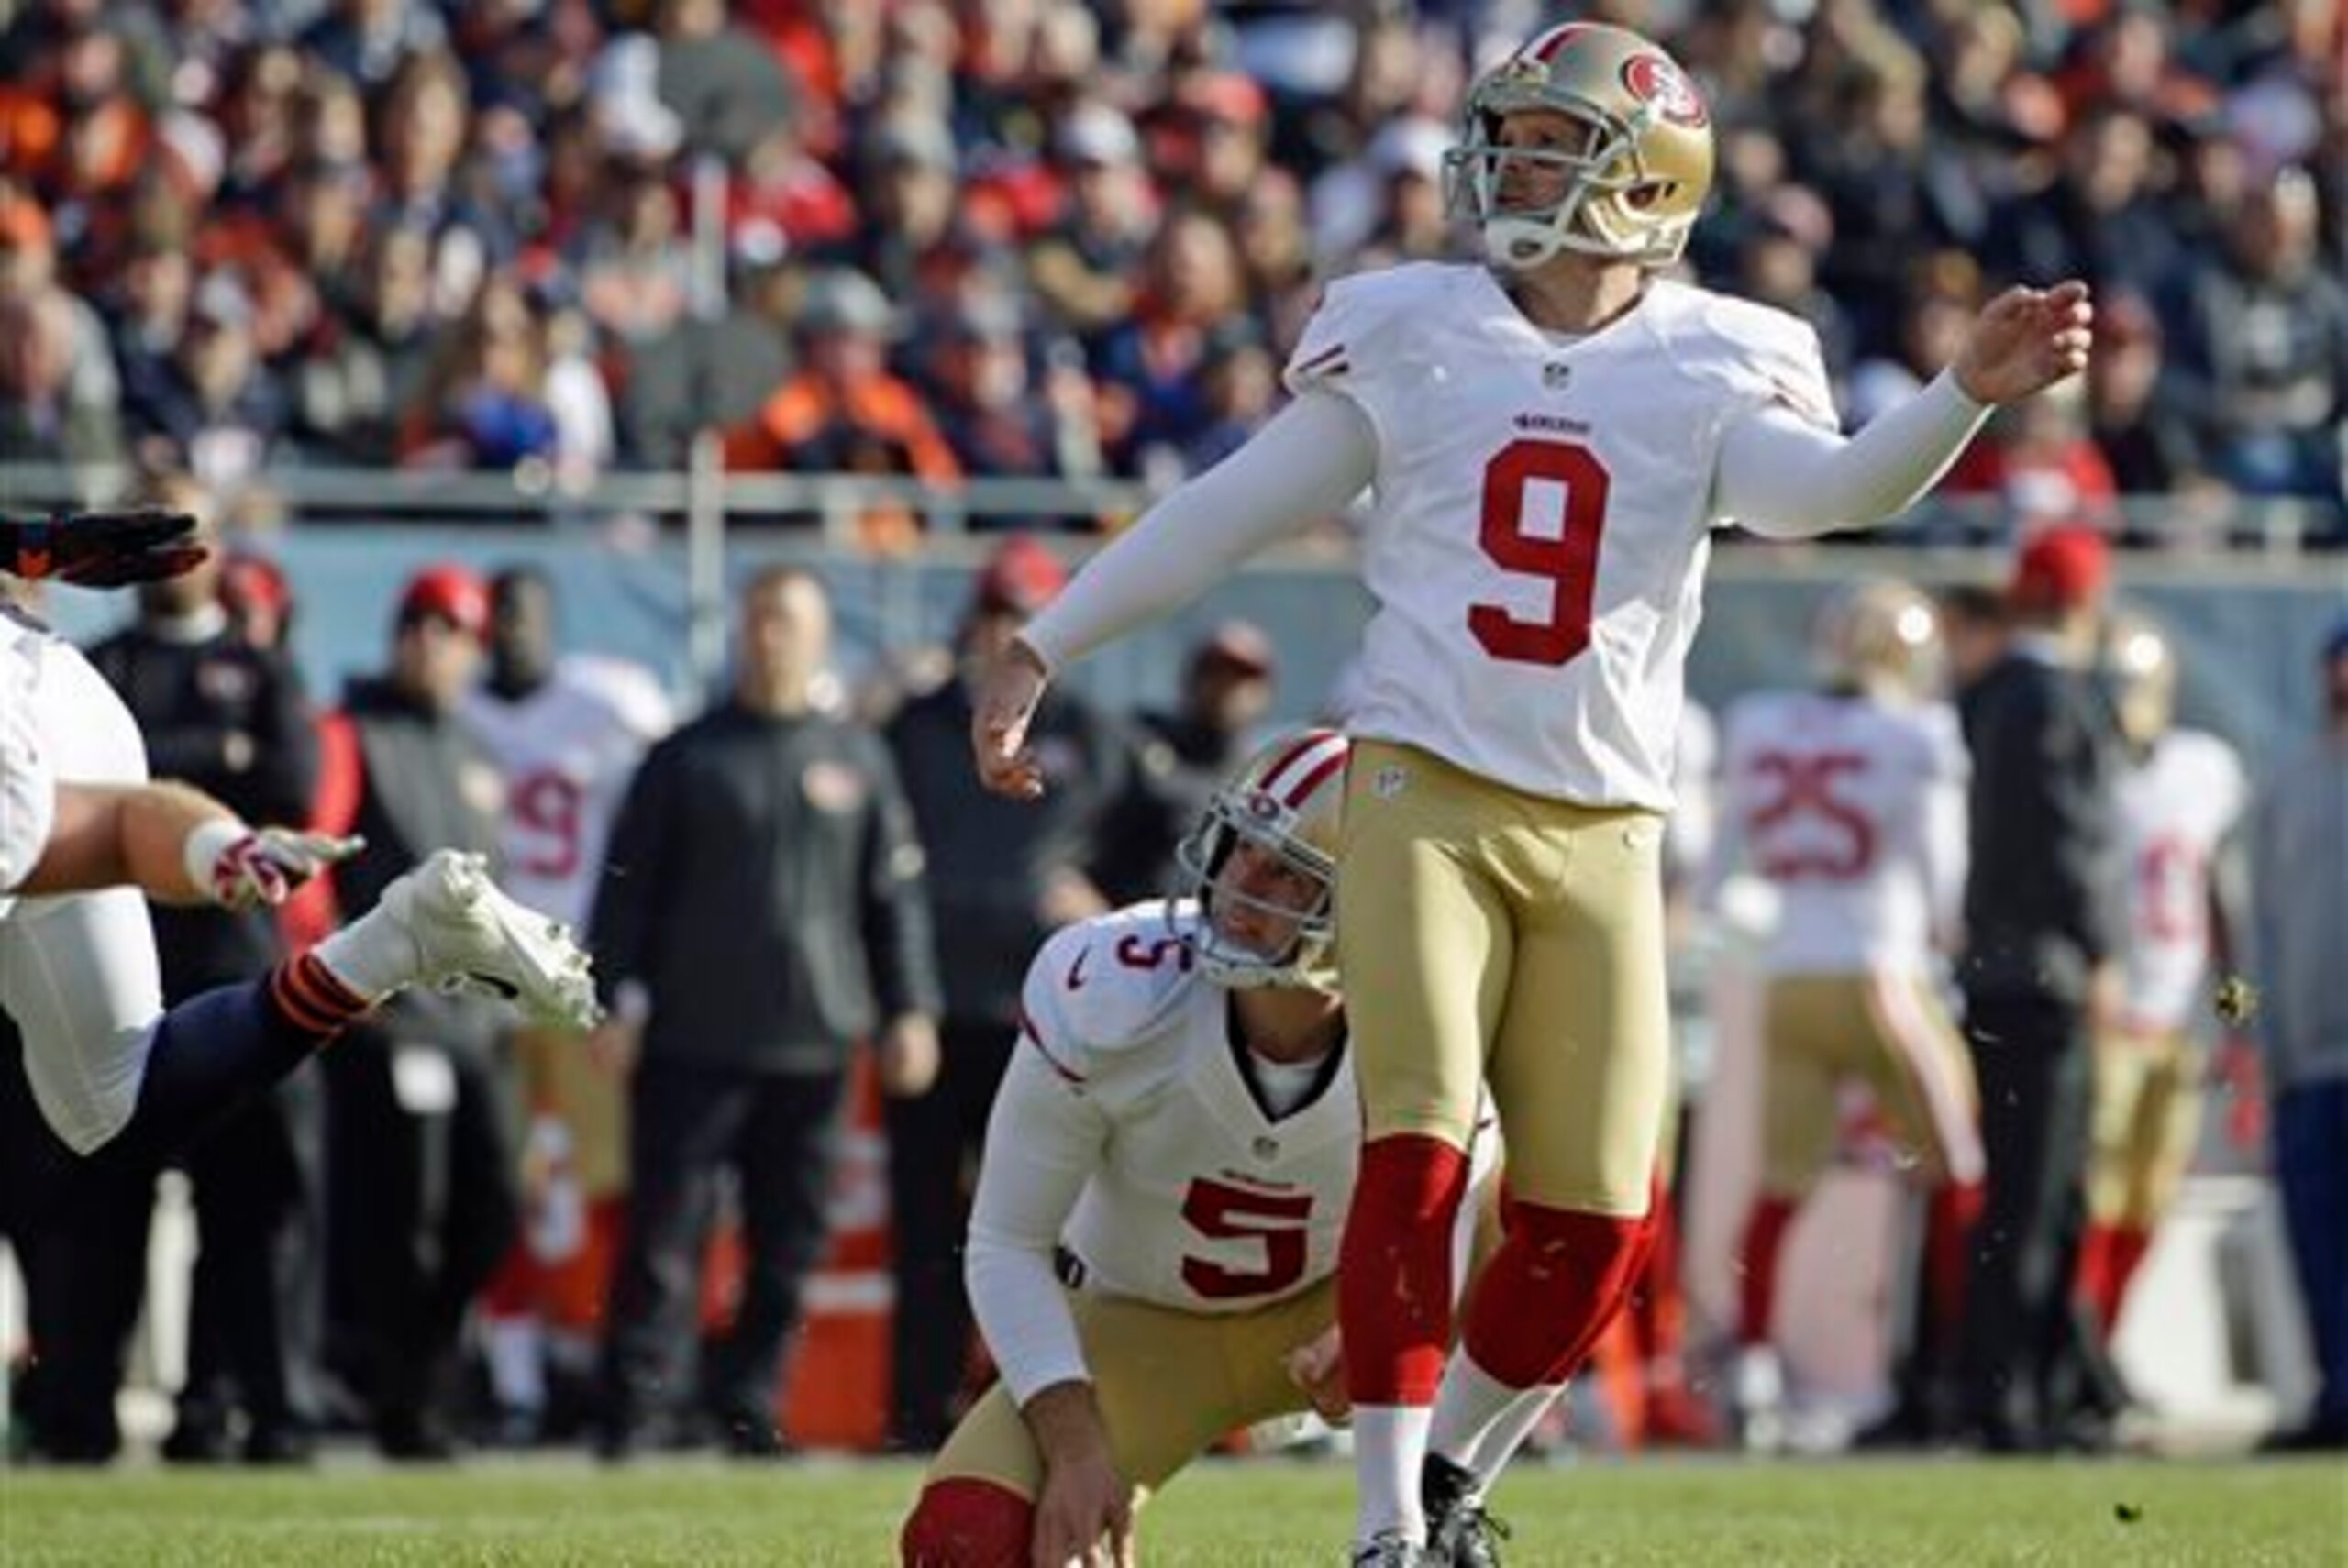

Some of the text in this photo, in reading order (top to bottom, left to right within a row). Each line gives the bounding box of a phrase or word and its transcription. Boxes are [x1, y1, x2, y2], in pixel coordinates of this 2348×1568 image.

[1468, 438, 1610, 665] 9
[1753, 752, 1877, 879] 25
[1181, 1178, 1313, 1297] 5
